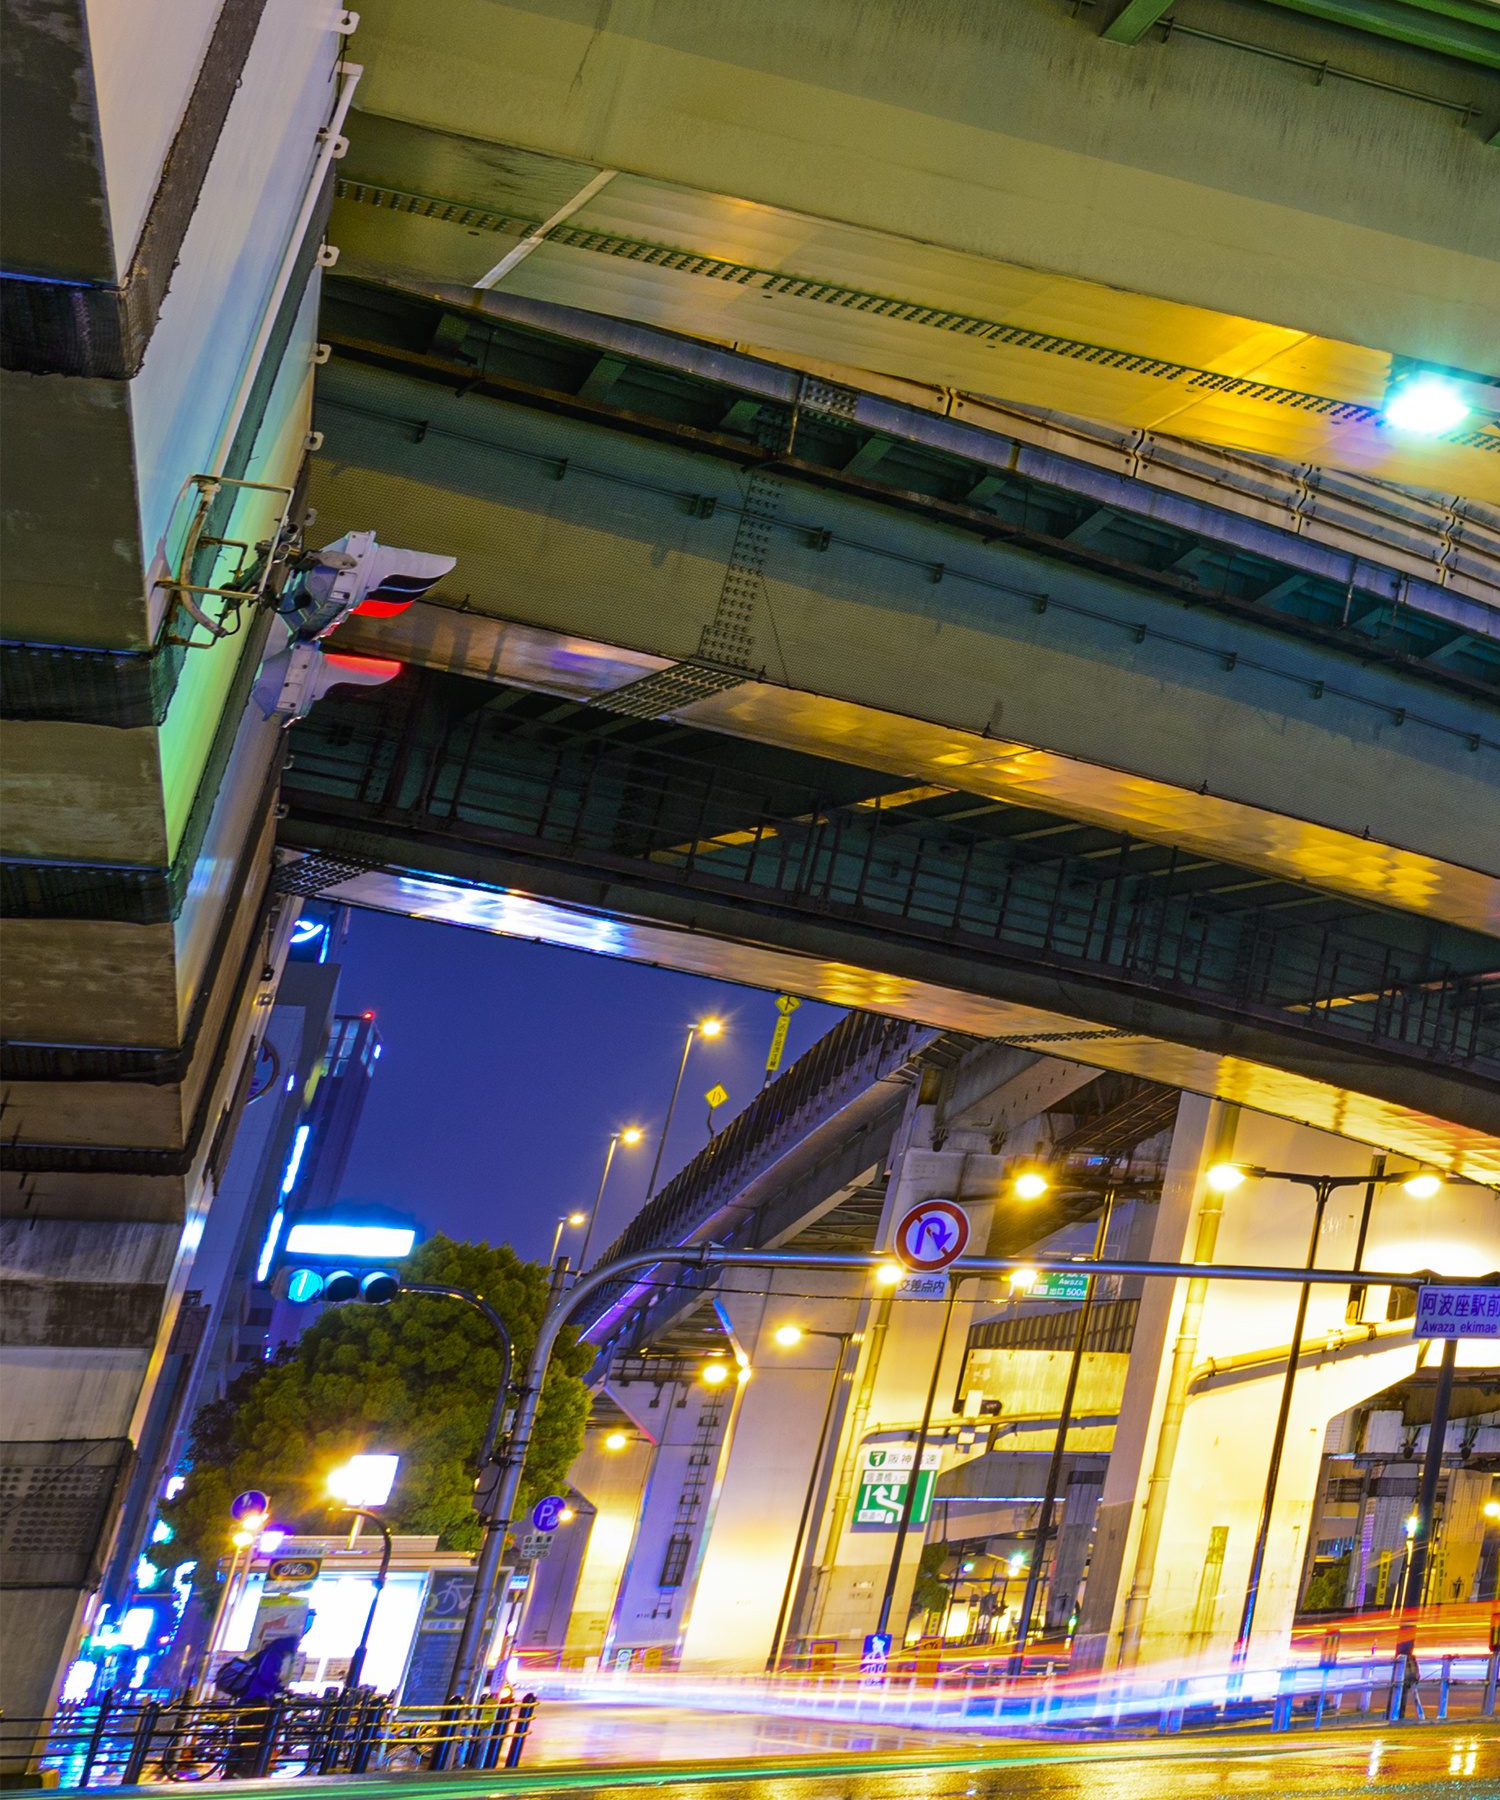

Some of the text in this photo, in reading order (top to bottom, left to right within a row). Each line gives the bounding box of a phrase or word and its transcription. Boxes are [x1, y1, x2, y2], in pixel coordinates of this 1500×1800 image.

[898, 1279, 945, 1294] 交差点内
[1421, 1320, 1497, 1334] Awaza ekimae
[889, 1453, 936, 1465] 阪神速
